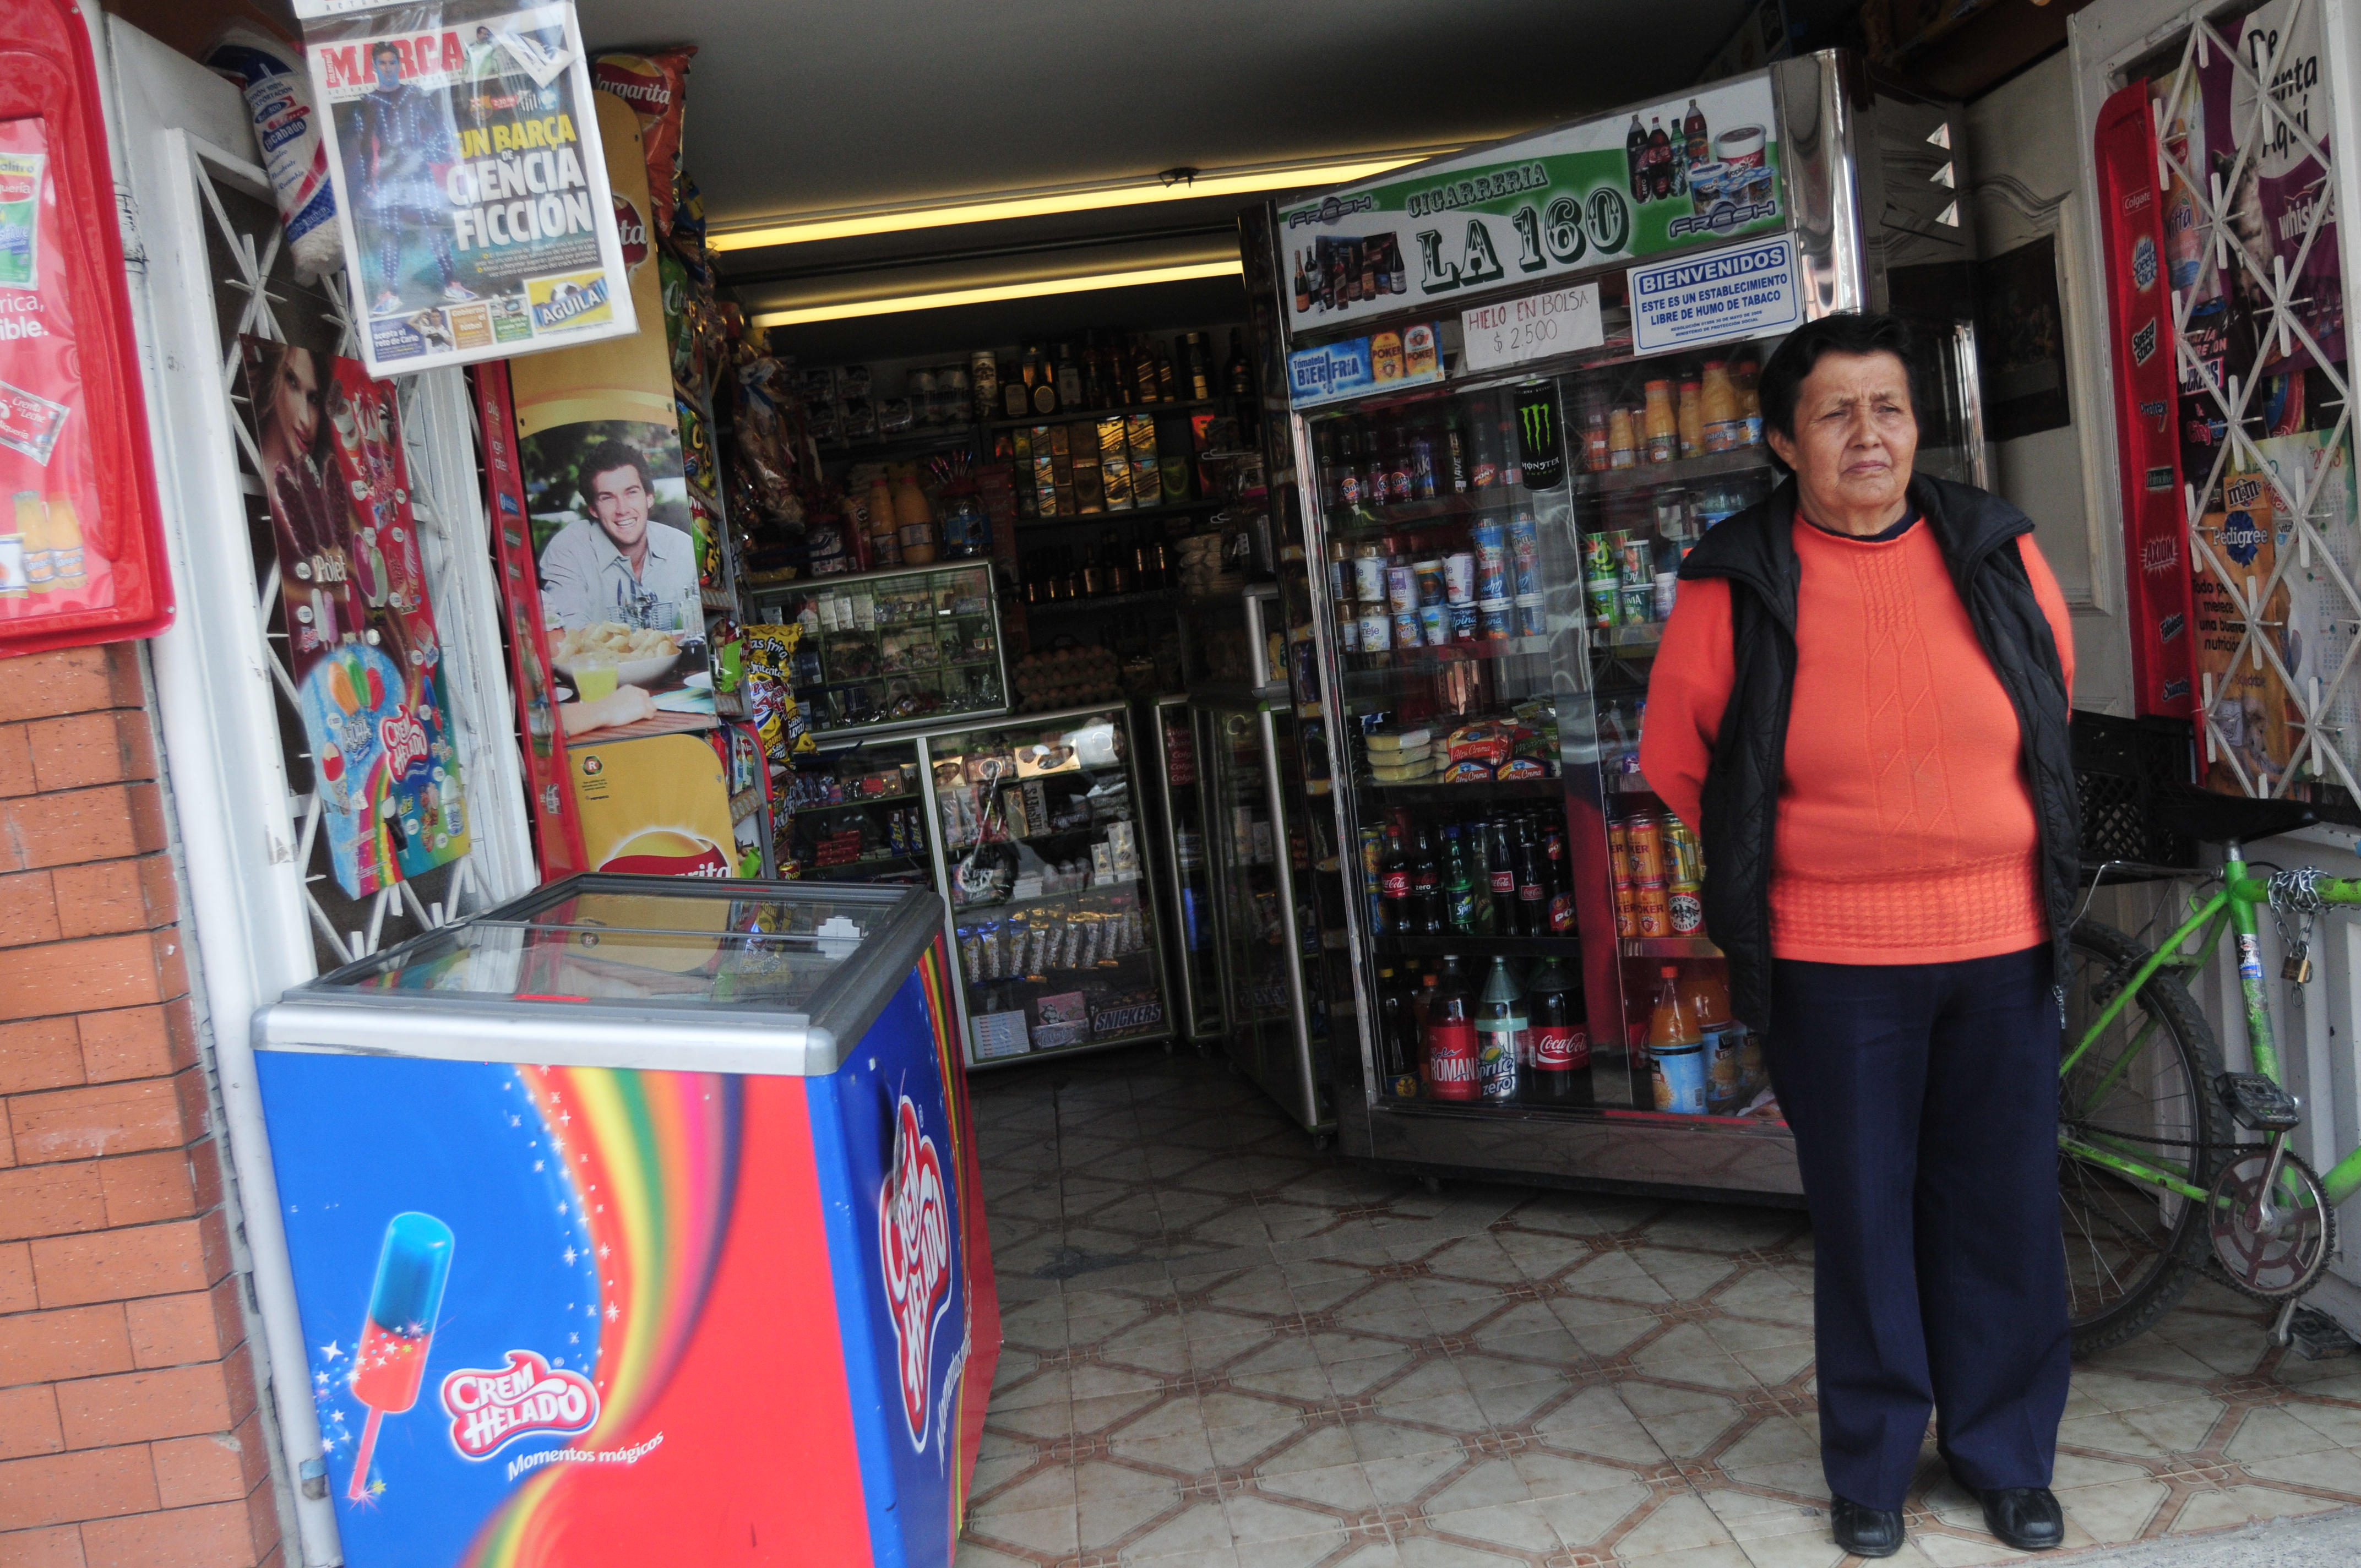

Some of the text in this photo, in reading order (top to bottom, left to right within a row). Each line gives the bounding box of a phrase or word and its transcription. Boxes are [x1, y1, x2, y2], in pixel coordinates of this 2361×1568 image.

[2271, 55, 2318, 100] enta
[459, 114, 576, 159] UN BARÇA
[501, 150, 514, 161] DE
[447, 147, 586, 206] CIENCIA
[1406, 162, 1549, 219] CIGARRERIA
[454, 191, 594, 251] FICCIÓN
[1289, 195, 1372, 230] FRESH
[1669, 200, 1776, 238] FRESH
[1416, 186, 1630, 296] LA 160
[1642, 248, 1783, 293] BIENVENIDOS
[542, 290, 603, 327] AGUILA
[1468, 290, 1589, 331] HIELO EN BOLSA
[1641, 273, 1788, 313] ESTE ES UN ESTABLECIMIENTO
[1651, 290, 1781, 326] LIBRE DE HUMO DE TABACO
[1510, 318, 1558, 350] 2.500
[1293, 355, 1325, 370] Tómatela
[1373, 346, 1402, 360] POKER
[1406, 347, 1434, 361] POKER
[1296, 365, 1326, 386] BIEN
[12, 396, 41, 413] Crema
[20, 409, 47, 423] Leche
[2140, 400, 2168, 417] Protex
[2145, 538, 2174, 567] AXION
[2212, 527, 2268, 549] Pedigree
[313, 554, 347, 582] Polet
[386, 712, 412, 747] CREM
[393, 729, 428, 776] HELADO
[1095, 1003, 1161, 1031] SNICKERS
[1482, 1077, 1513, 1096] zero
[450, 1359, 536, 1412] CREM
[463, 1385, 588, 1449] HELADO
[508, 1431, 664, 1482] Momentos mágicos
